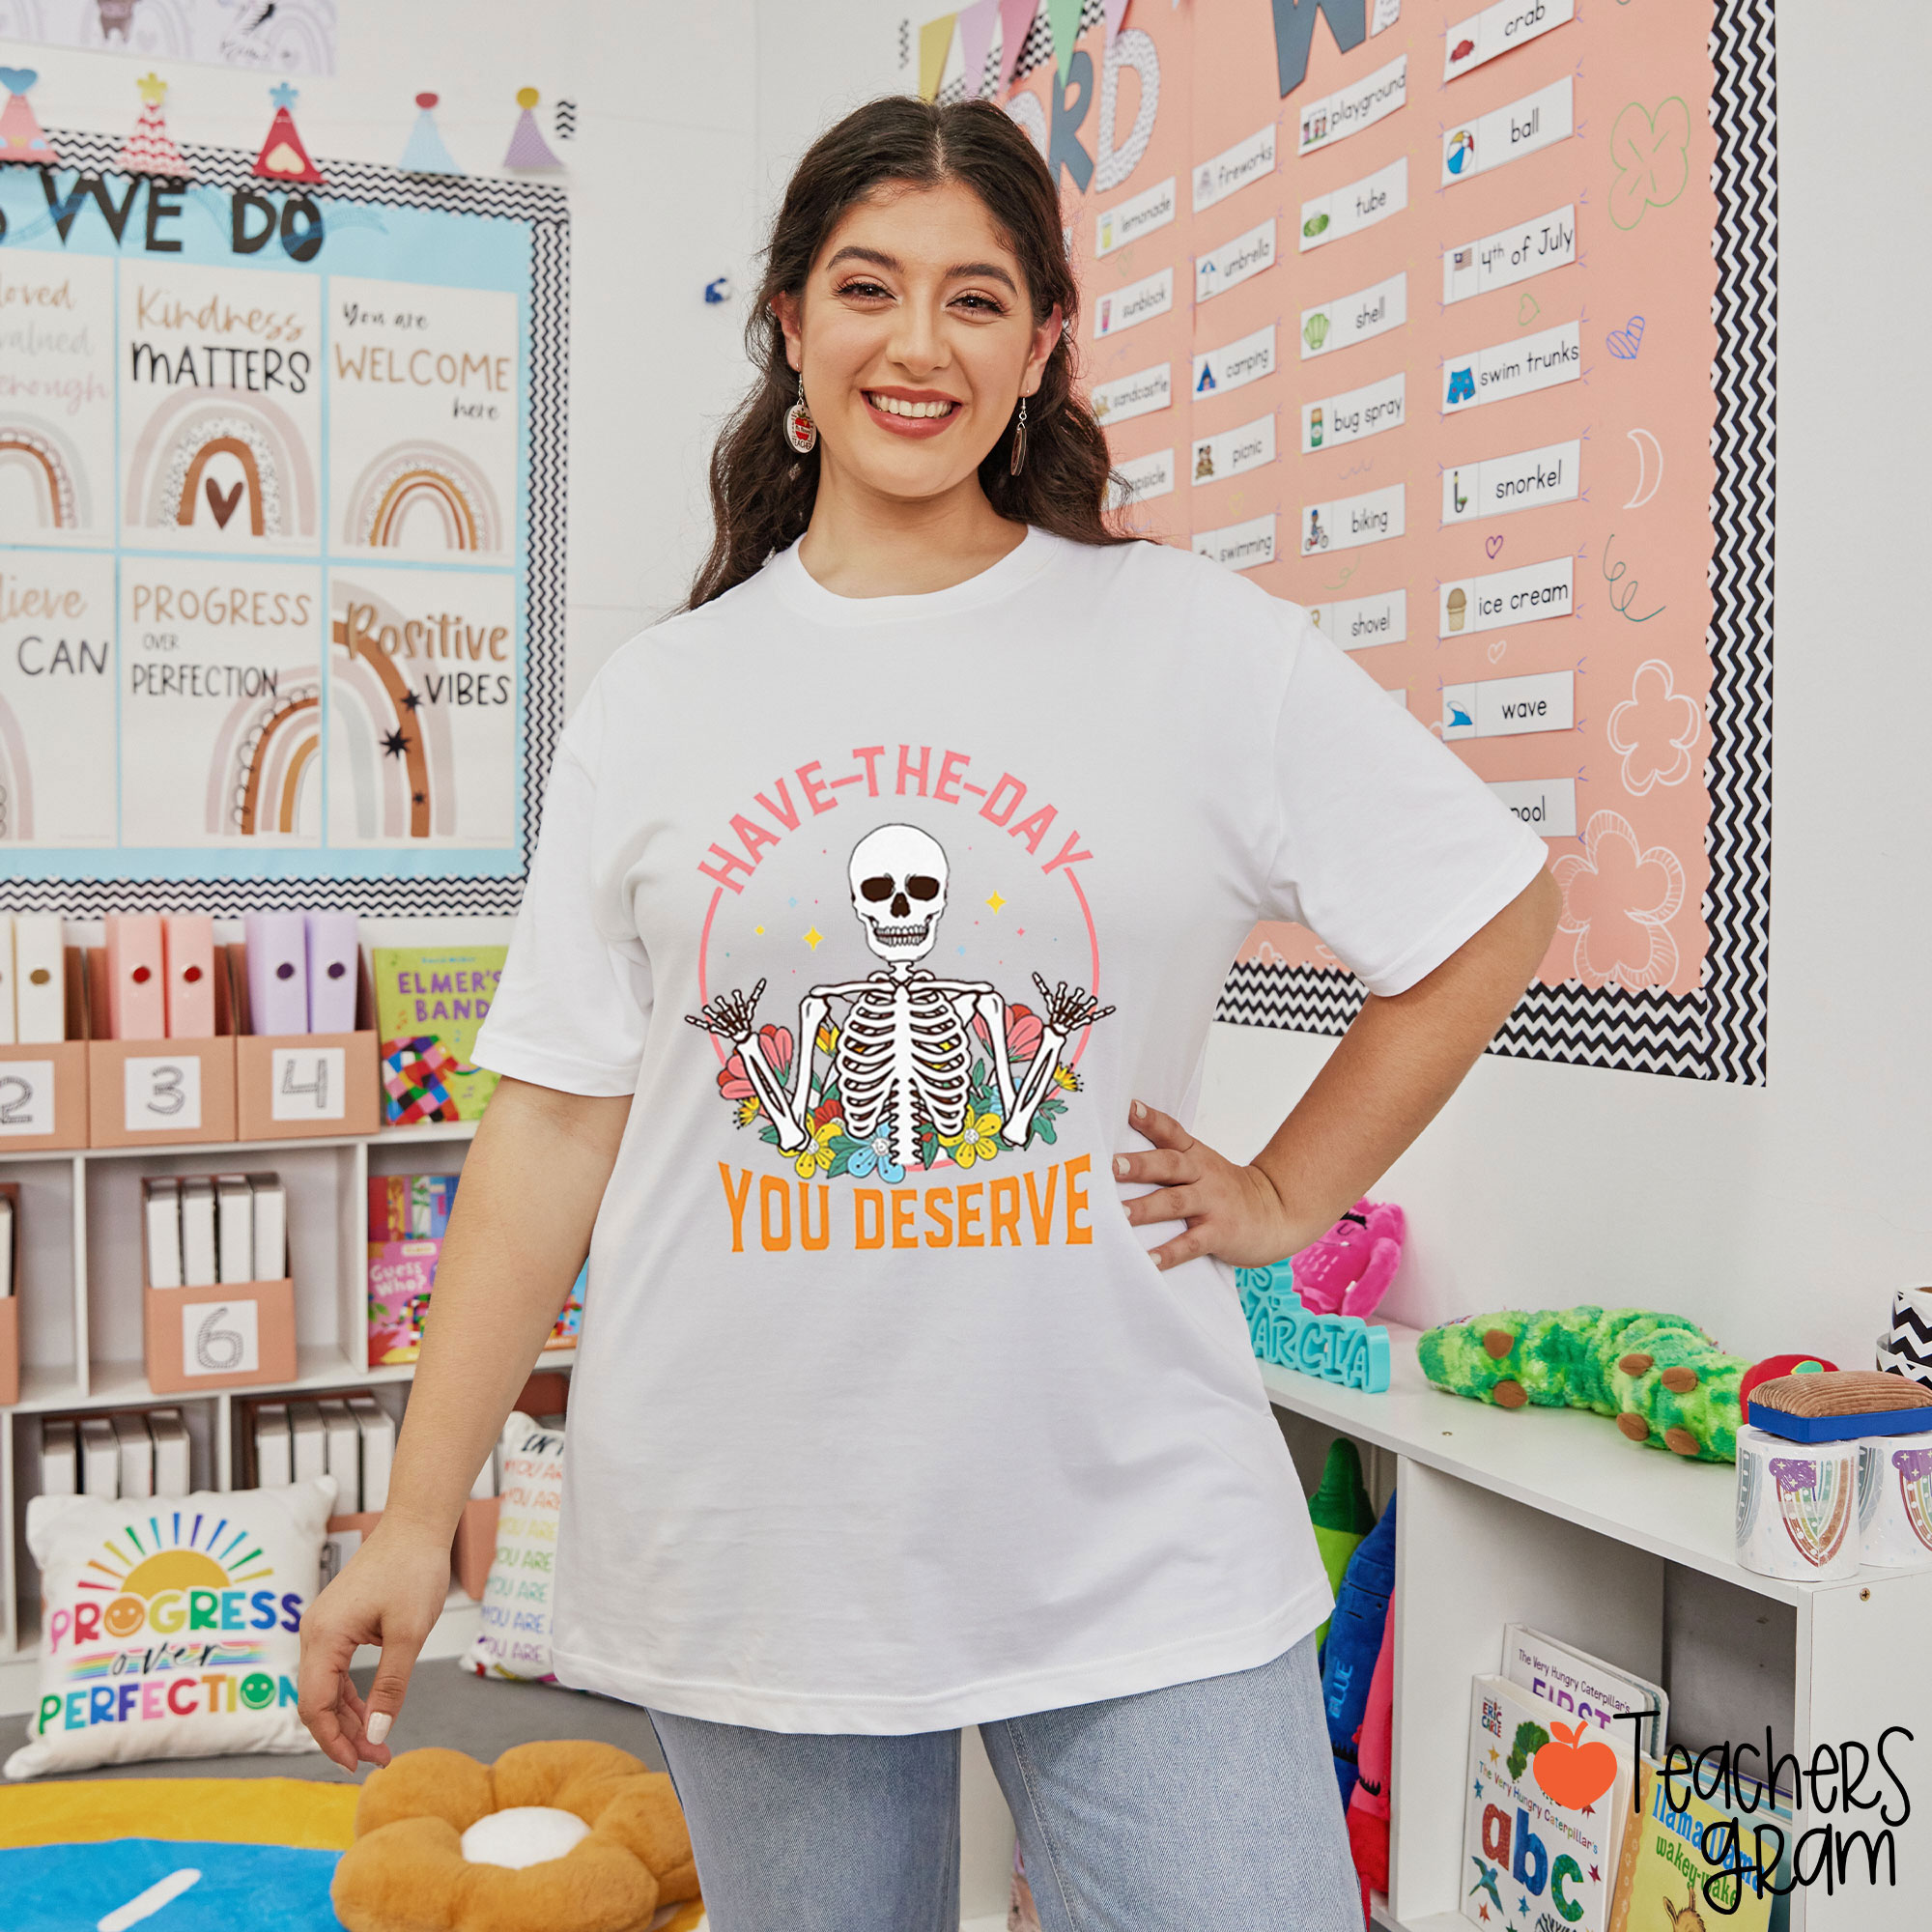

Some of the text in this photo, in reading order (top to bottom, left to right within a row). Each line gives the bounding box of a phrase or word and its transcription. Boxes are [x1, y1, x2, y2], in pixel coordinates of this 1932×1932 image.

[1504, 0, 1546, 36] crab
[1005, 29, 1160, 197] RD
[1330, 64, 1407, 132] playground
[1511, 107, 1540, 144] ball
[1218, 142, 1273, 187] fireworks
[40, 171, 186, 252] WE
[232, 191, 324, 262] DO
[1121, 192, 1172, 233] lemonade
[1356, 187, 1386, 218] tube
[1224, 237, 1270, 277] umbrella
[1481, 222, 1574, 273] 4th of July
[135, 284, 305, 343] Kindness
[343, 301, 428, 329] You are
[1122, 281, 1166, 319] sunblock
[1355, 295, 1385, 329] shell
[131, 341, 310, 394] MATTERS
[334, 342, 512, 392] WELCOME
[1226, 348, 1269, 379] camping
[1479, 340, 1579, 386] swim trunks
[453, 396, 500, 421] here
[1113, 373, 1169, 408] sandcastle
[1333, 397, 1403, 434] bug spray
[1232, 440, 1263, 469] picnic
[1129, 464, 1166, 496] psicle
[1495, 459, 1563, 499] snorkel
[1351, 508, 1388, 534] biking
[1220, 535, 1272, 563] swimming
[132, 583, 311, 627] PROGRESS
[1478, 583, 1569, 616] ice cream
[347, 602, 509, 662] Positive
[1351, 606, 1391, 637] shovel
[17, 635, 109, 676] CAN
[142, 633, 180, 652] OVER
[131, 664, 279, 697] PERFECTION
[424, 672, 512, 706] VIBES
[1501, 700, 1548, 720] wave
[415, 999, 492, 1023] BAND
[0, 1075, 33, 1124] 2
[147, 1065, 185, 1116] 3
[281, 1058, 328, 1110] 4
[718, 1152, 1094, 1254] YOU DESERVE
[370, 1261, 423, 1281] Guess
[375, 1273, 427, 1297] Who?
[196, 1308, 244, 1370] 6
[522, 1550, 554, 1574] ARE
[516, 1581, 549, 1604] ARE
[50, 1590, 303, 1654] PROGRESS
[512, 1612, 547, 1634] ARE
[111, 1643, 248, 1678] over
[510, 1640, 544, 1663] ARE
[1329, 1660, 1353, 1719] BLUE
[1519, 1648, 1631, 1715] The Very Hungry Caterpillar's
[38, 1671, 299, 1736] PERFECTION
[1482, 1700, 1503, 1725] ERIC
[1481, 1715, 1502, 1739] CARLE
[1479, 1760, 1599, 1855] The Very Hungry Caterpillar's
[1652, 1783, 1703, 1851] llama
[1481, 1803, 1584, 1922] abc
